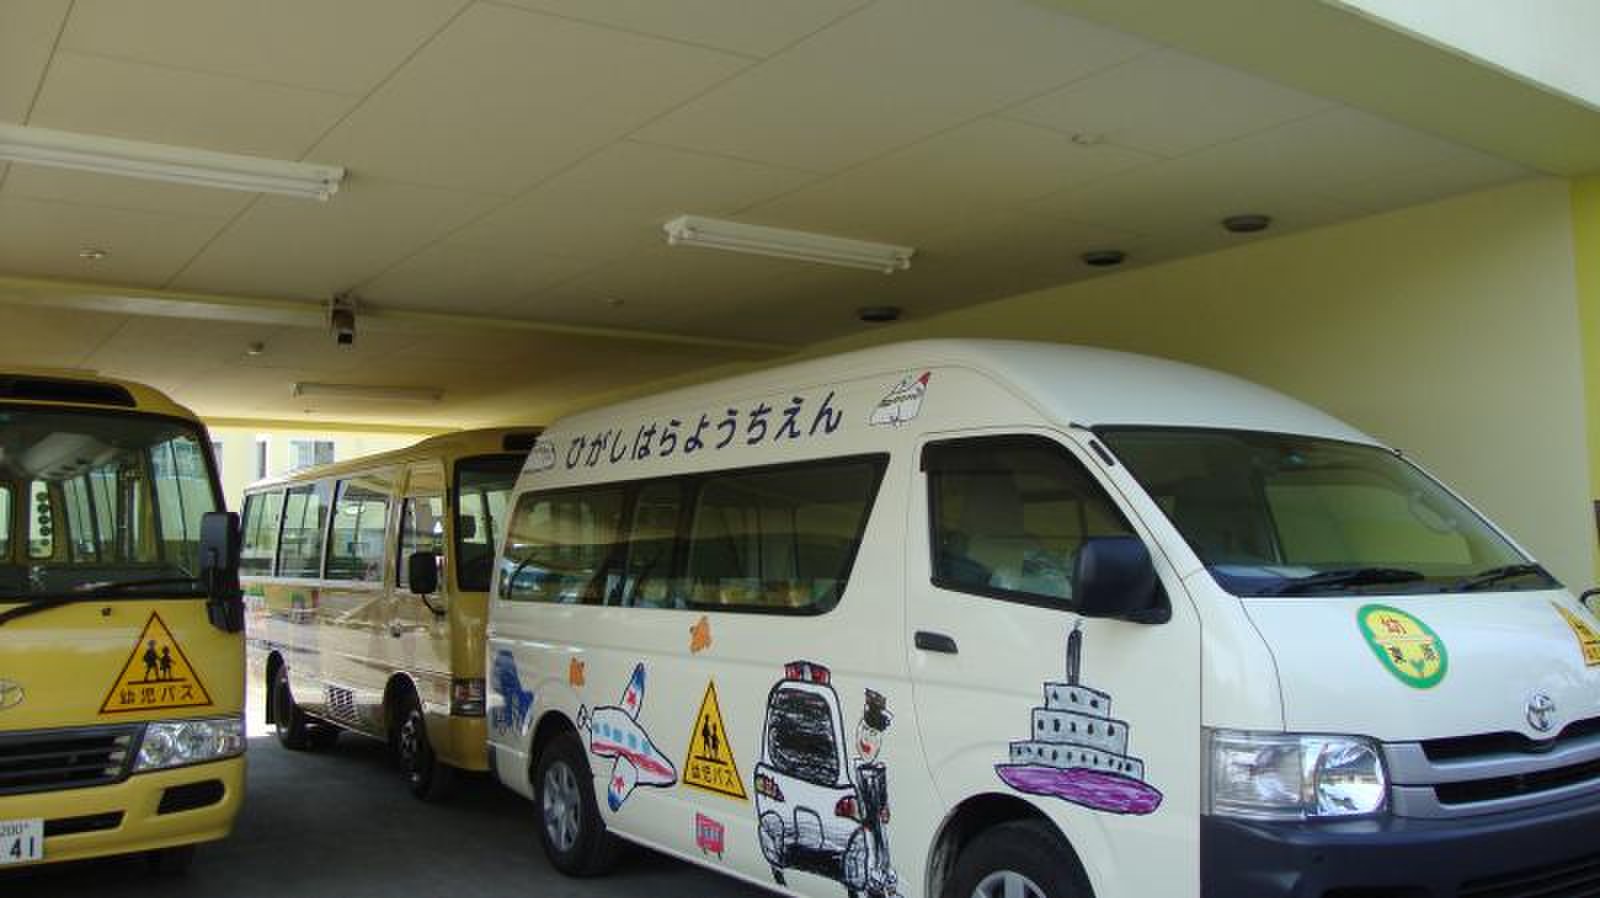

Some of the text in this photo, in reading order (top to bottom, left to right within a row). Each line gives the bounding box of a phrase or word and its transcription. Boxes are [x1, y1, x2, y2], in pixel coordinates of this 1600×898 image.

[565, 391, 843, 470] ひがしはらようちえん
[119, 684, 195, 705] 幼児バス
